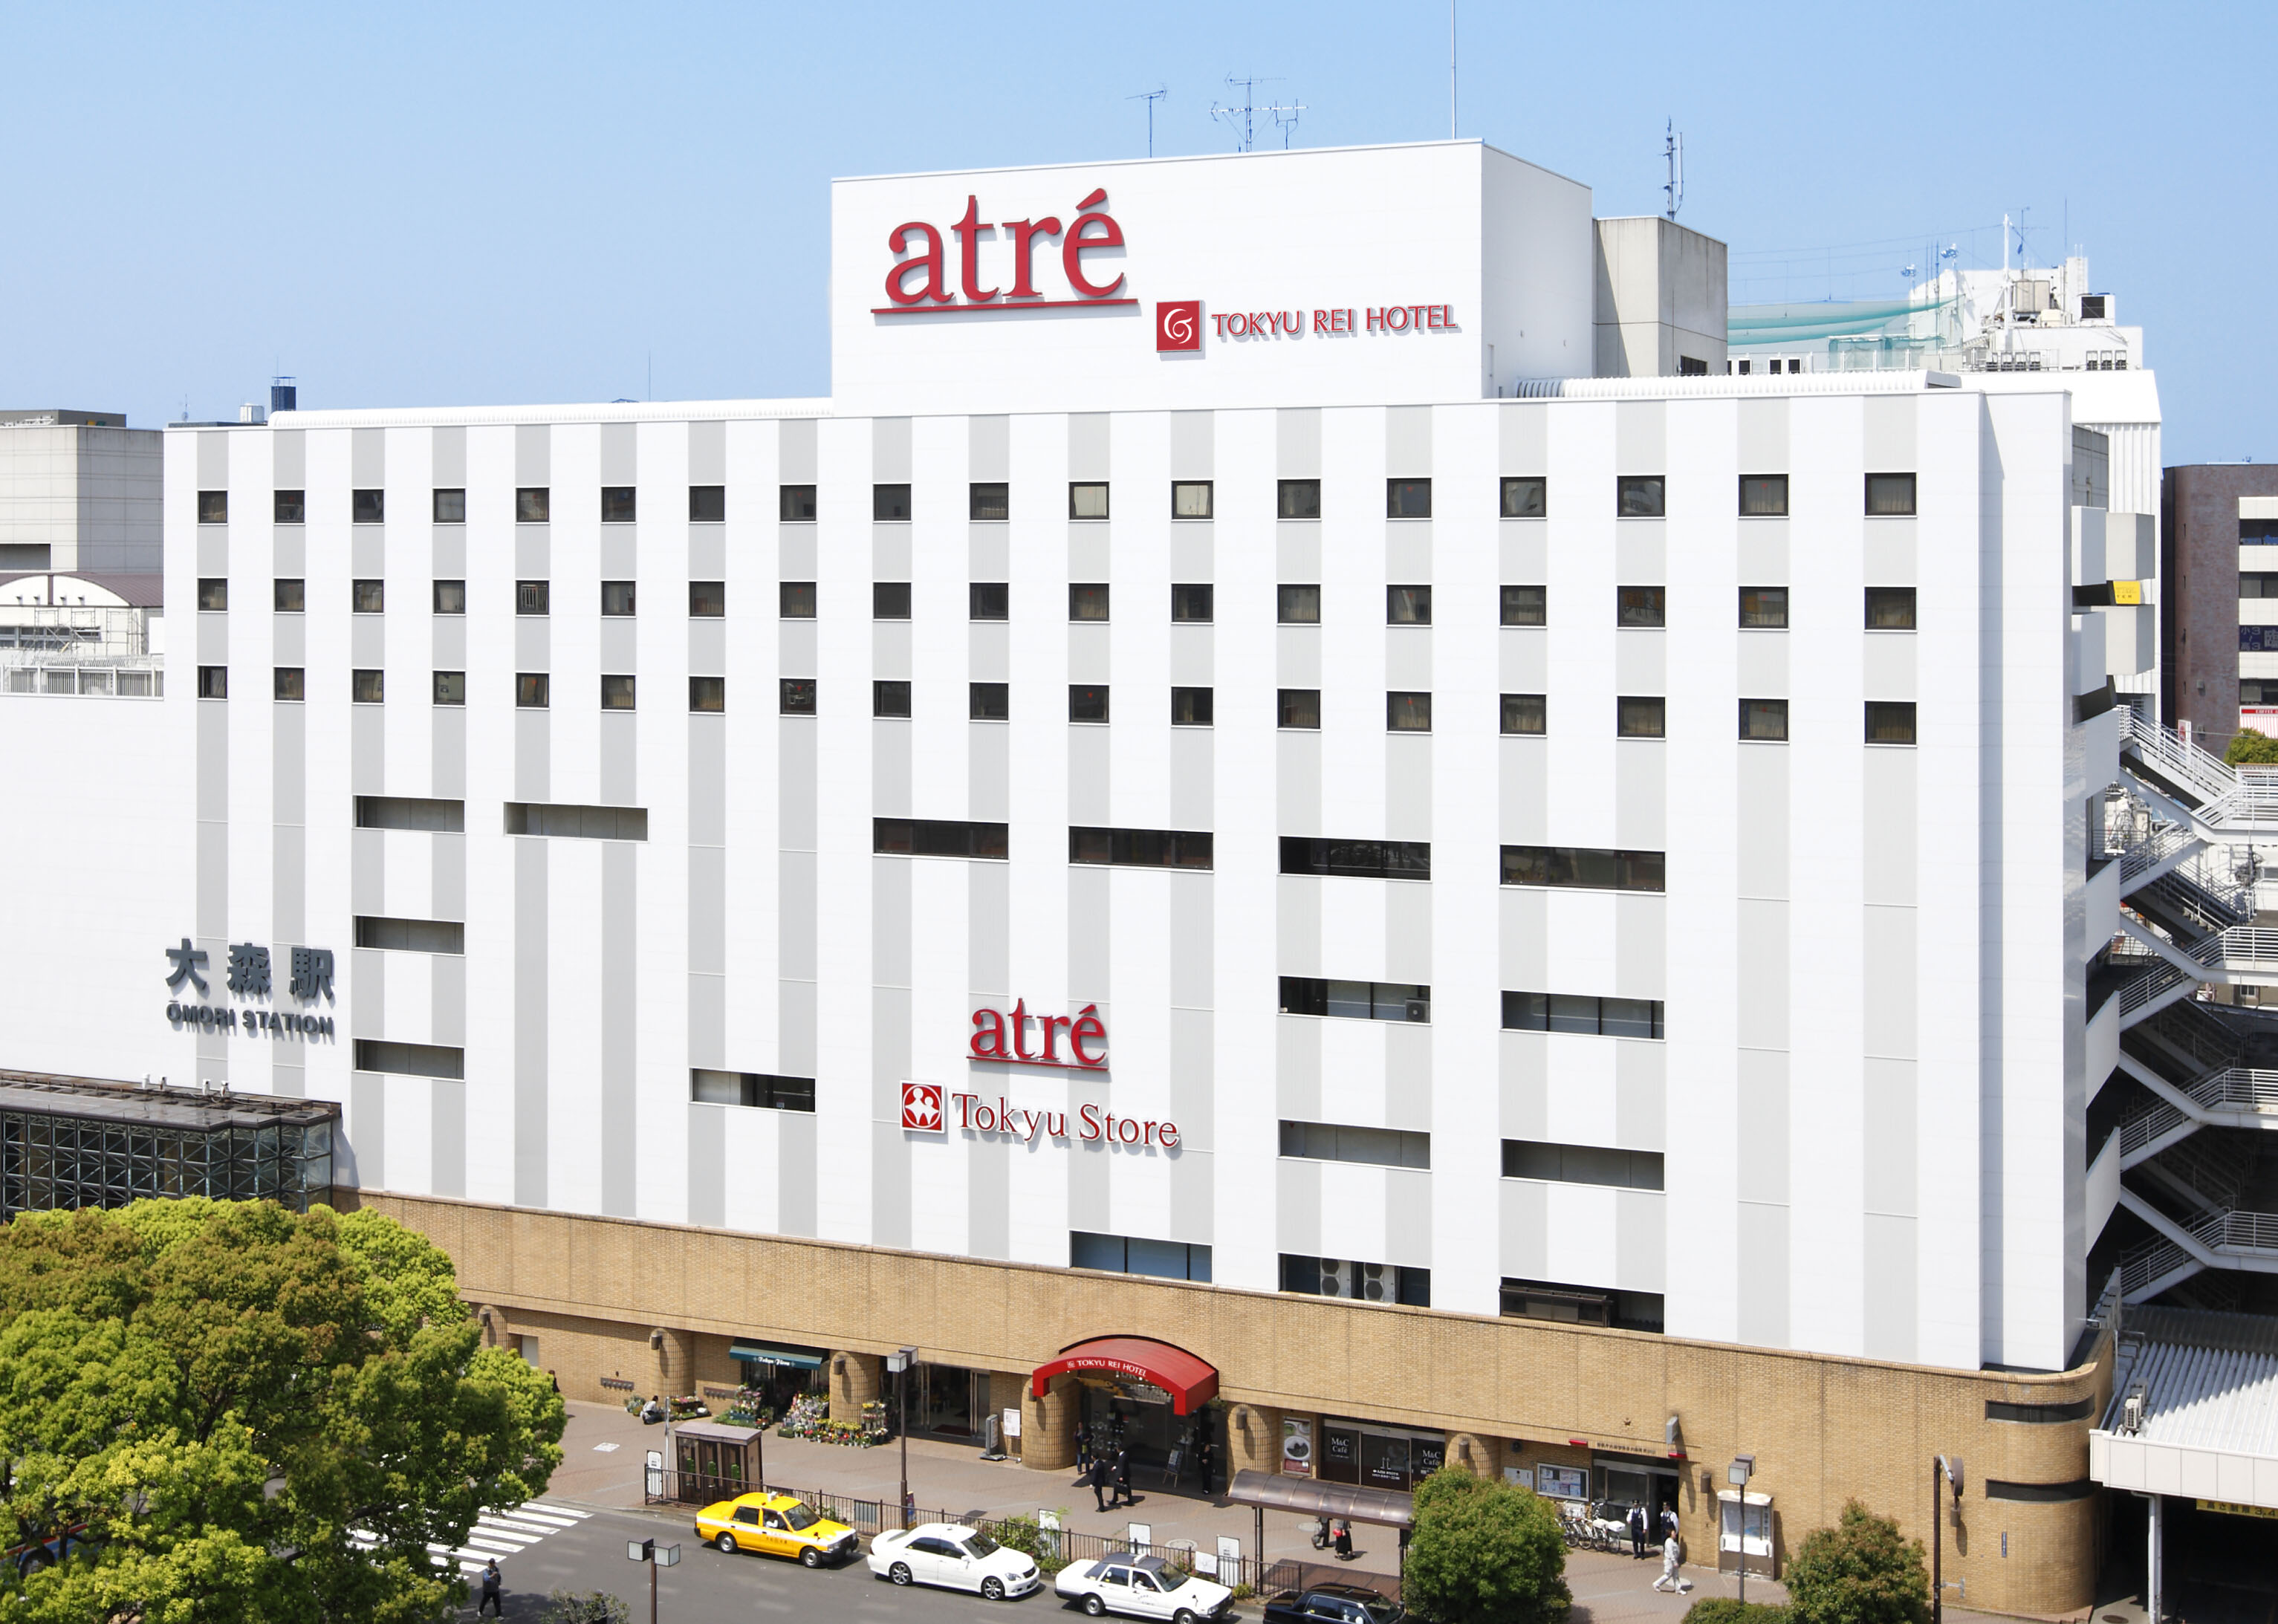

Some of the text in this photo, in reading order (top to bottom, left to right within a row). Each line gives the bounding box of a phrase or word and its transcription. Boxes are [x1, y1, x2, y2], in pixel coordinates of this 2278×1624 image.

[884, 187, 1125, 305] atré
[1211, 304, 1458, 337] TOKYU REI HOTEL
[165, 938, 334, 1000] 大森駅
[242, 1009, 334, 1036] STATION
[970, 997, 1107, 1065] atré
[951, 1092, 1180, 1149] Tokyu Store
[1077, 1359, 1106, 1367] TOKYU
[1108, 1360, 1120, 1368] REI
[1123, 1363, 1147, 1377] HOTEL
[1331, 1436, 1350, 1447] M&C
[1332, 1446, 1348, 1454] Café
[1422, 1449, 1441, 1459] M&C
